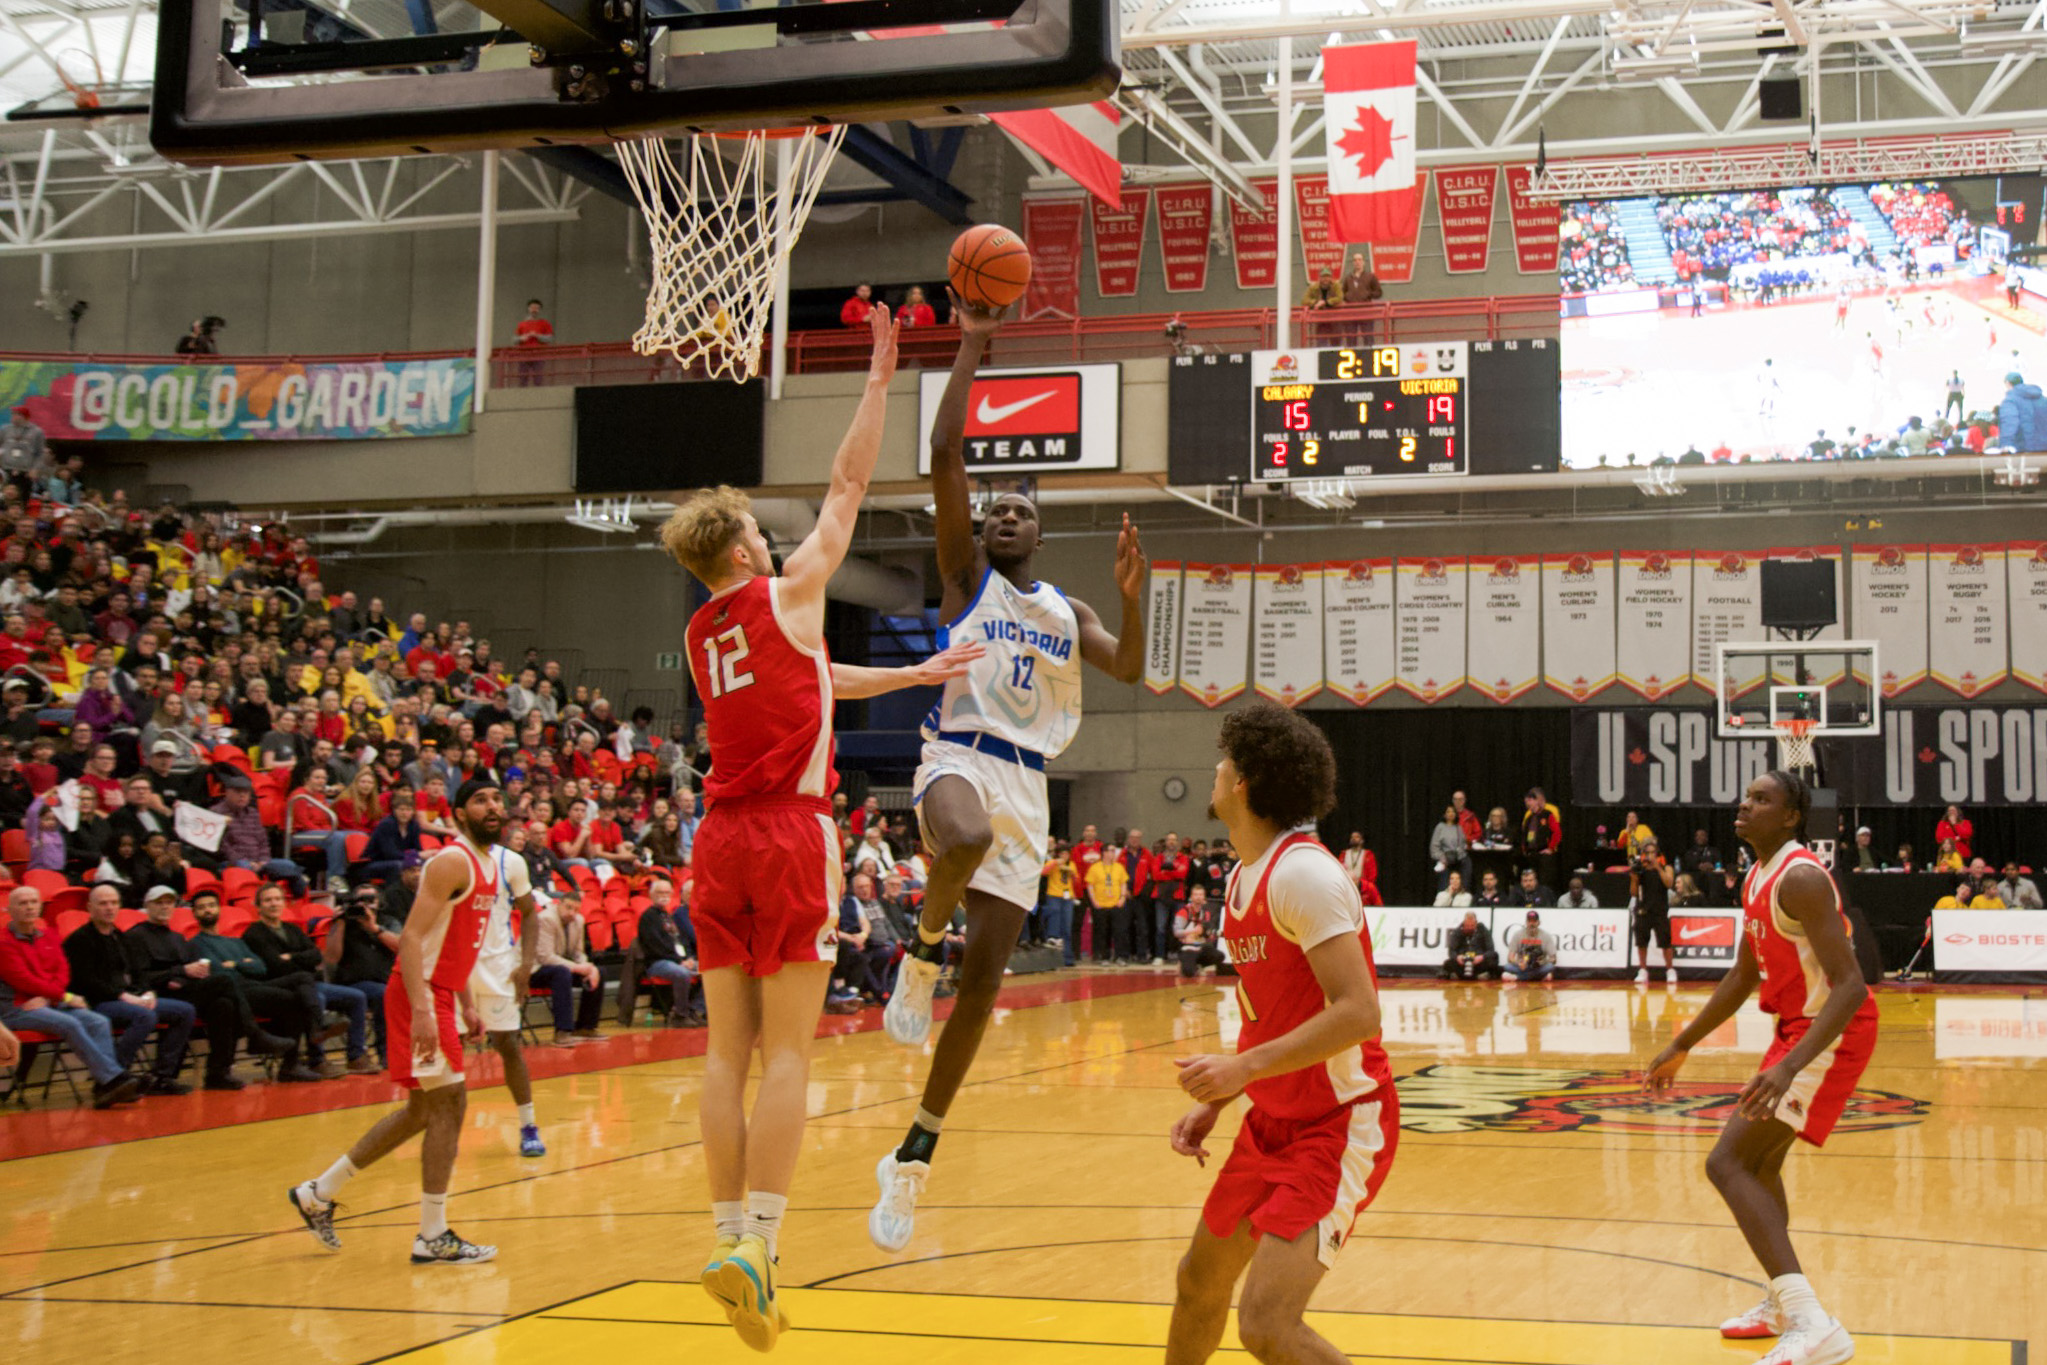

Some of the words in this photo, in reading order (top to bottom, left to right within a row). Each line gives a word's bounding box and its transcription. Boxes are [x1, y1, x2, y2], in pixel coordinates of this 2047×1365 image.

[1443, 175, 1491, 189] C.I.A.U.
[1444, 195, 1491, 209] U.S.I.C.
[1532, 339, 1546, 349] PTS
[1230, 354, 1243, 363] PTS
[1337, 348, 1400, 380] 2:19
[1263, 385, 1314, 401] CALGARY
[1401, 378, 1458, 395] VICTORIA
[70, 367, 458, 431] @COLD_GARDEN
[1345, 392, 1373, 402] PERIOD
[1285, 401, 1310, 430] 15
[1358, 402, 1368, 424] 1
[1428, 395, 1454, 423] 19
[1263, 433, 1289, 443] FOULS
[1329, 430, 1360, 440] PLAYER
[1368, 428, 1389, 439] FOUL
[1429, 426, 1455, 437] FOULS
[971, 438, 1066, 459] TEAM
[1272, 442, 1288, 466] 2
[1303, 440, 1319, 465] 2
[1400, 437, 1416, 462] 2
[1445, 436, 1454, 459] 1
[1263, 468, 1289, 478] SCORE
[1345, 465, 1372, 475] MATCH
[1428, 462, 1454, 472] SCORE
[1871, 565, 1907, 574] DINOS
[1949, 565, 1985, 574] DINOS
[1635, 588, 1674, 596] WOMEN'S
[1561, 598, 1596, 606] CURLING
[1192, 607, 1240, 615] BASKETBALL
[1151, 590, 1163, 669] CONFERENCE
[1161, 580, 1175, 676] CHAMPIONSHIPS
[982, 619, 1073, 661] VICTORIA
[703, 623, 755, 699] 12
[1011, 654, 1035, 691] 12
[1598, 712, 1625, 803] U
[1885, 710, 1914, 802] U
[1675, 946, 1726, 957] TEAM
